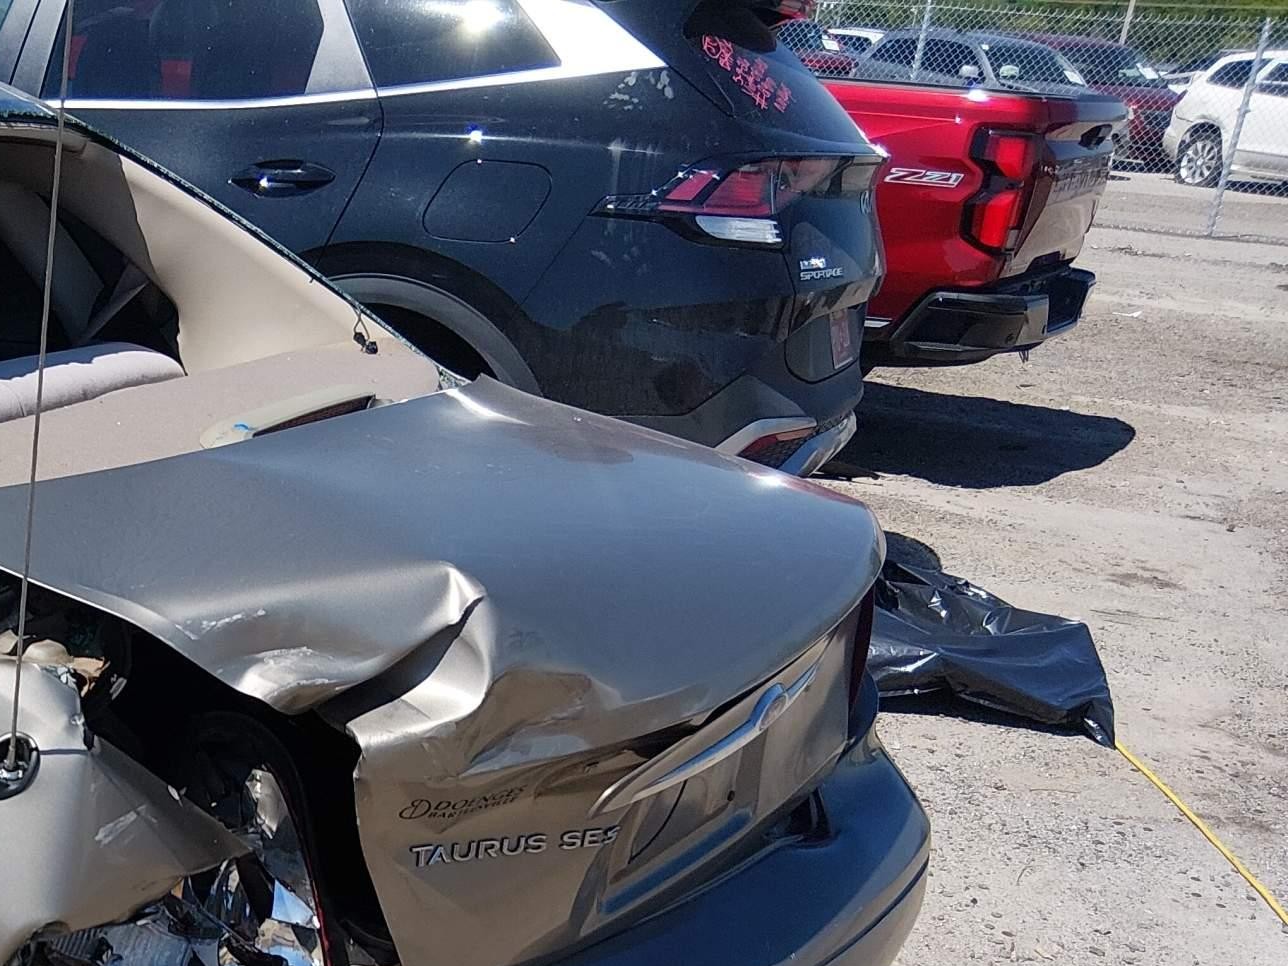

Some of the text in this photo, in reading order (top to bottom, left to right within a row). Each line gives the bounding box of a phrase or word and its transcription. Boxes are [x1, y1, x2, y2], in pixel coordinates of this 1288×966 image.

[884, 167, 965, 188] Z71
[410, 826, 621, 868] TAURUS SES
